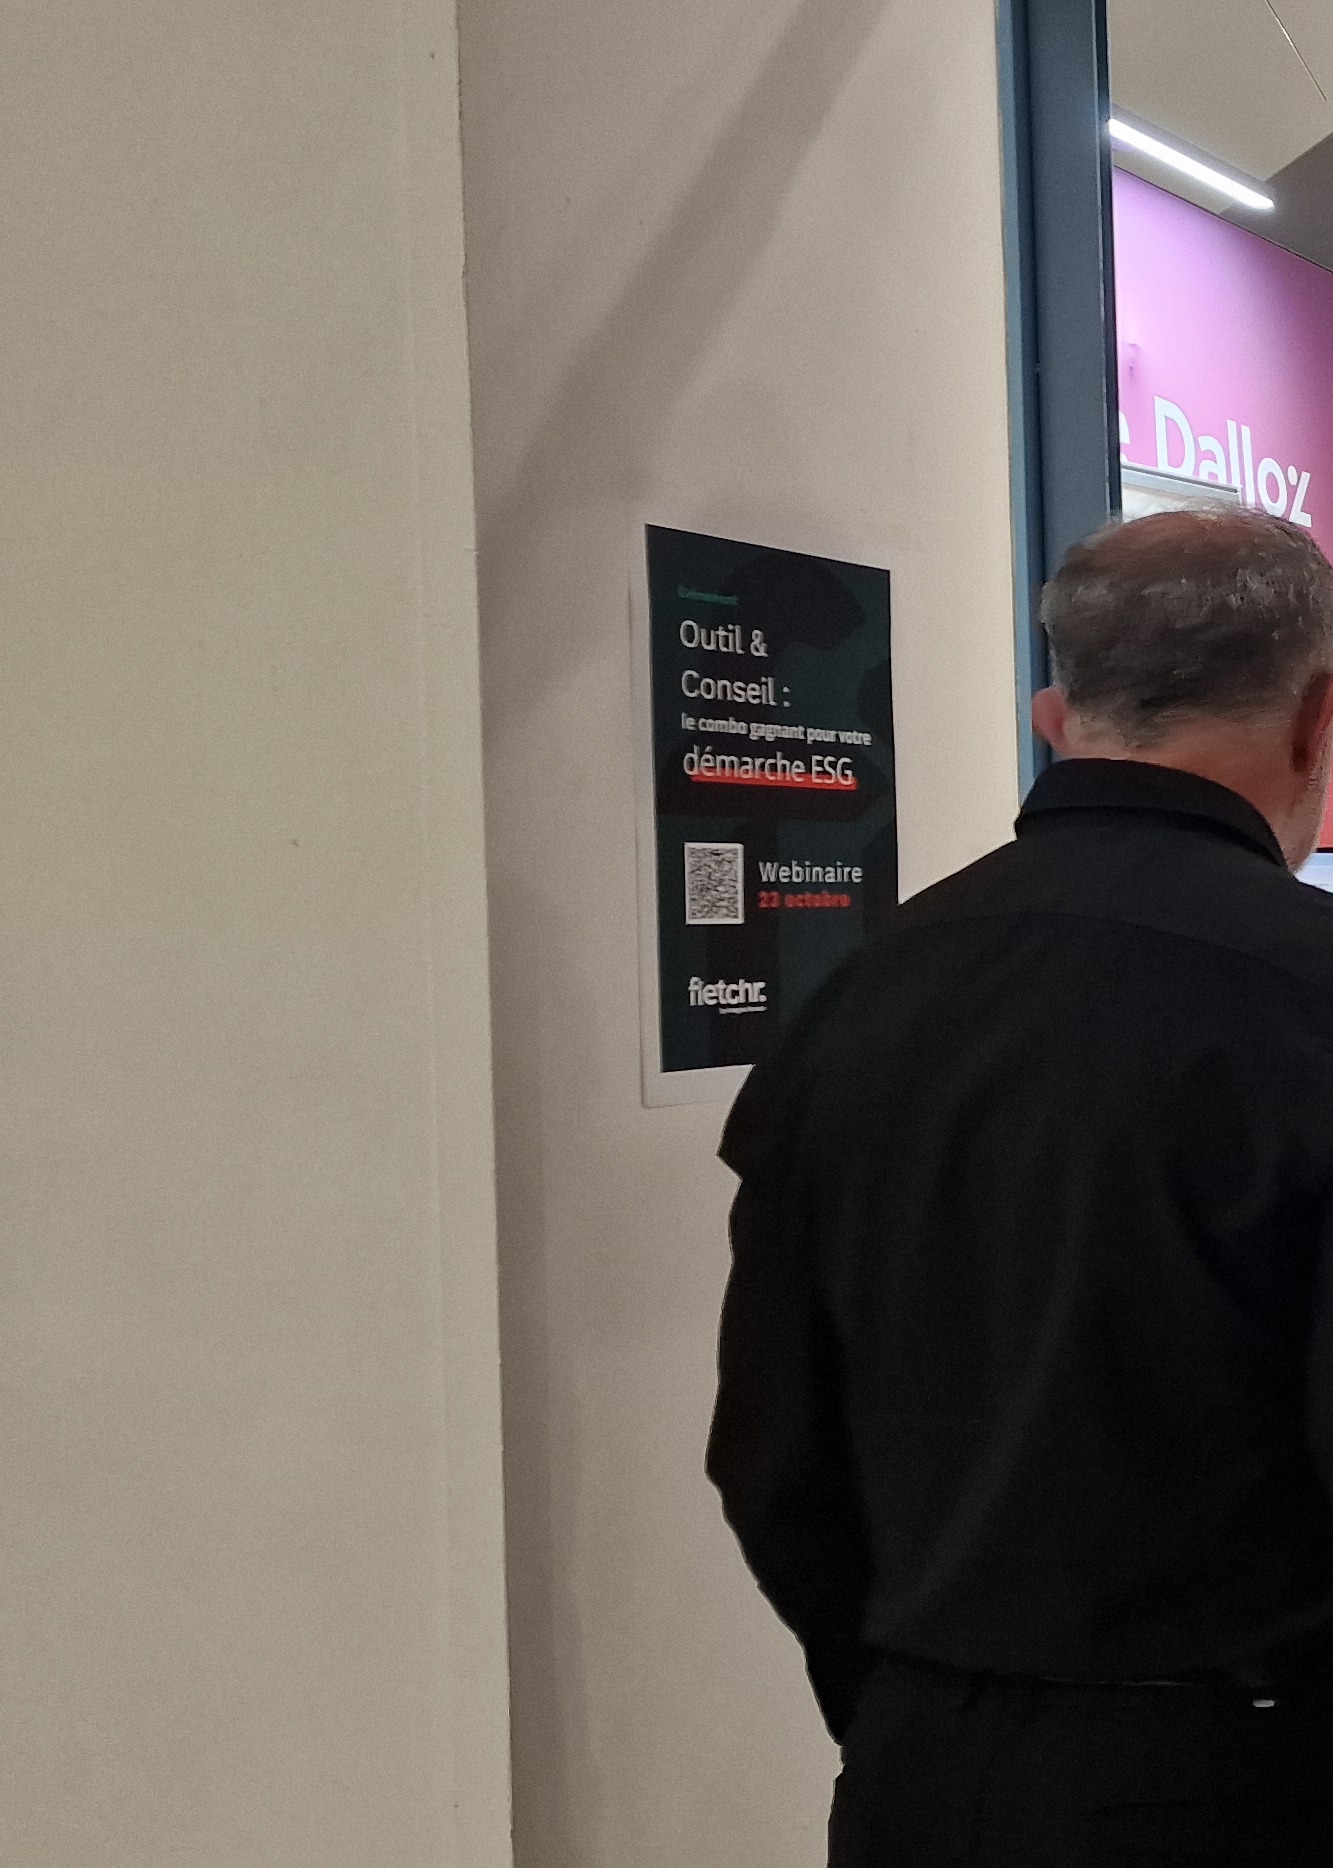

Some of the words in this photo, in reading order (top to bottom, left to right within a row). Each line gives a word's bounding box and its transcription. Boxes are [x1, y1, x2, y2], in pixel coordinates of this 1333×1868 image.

[679, 619, 745, 655] Outil
[750, 629, 769, 658] &
[681, 669, 778, 707] Conseil
[681, 712, 701, 731] le
[698, 716, 750, 736] combo
[748, 721, 806, 742] gagnant
[806, 726, 840, 745] pour
[838, 729, 873, 746] votre
[682, 744, 807, 783] démarche
[810, 754, 854, 785] ESG
[758, 859, 863, 883] Webinaire
